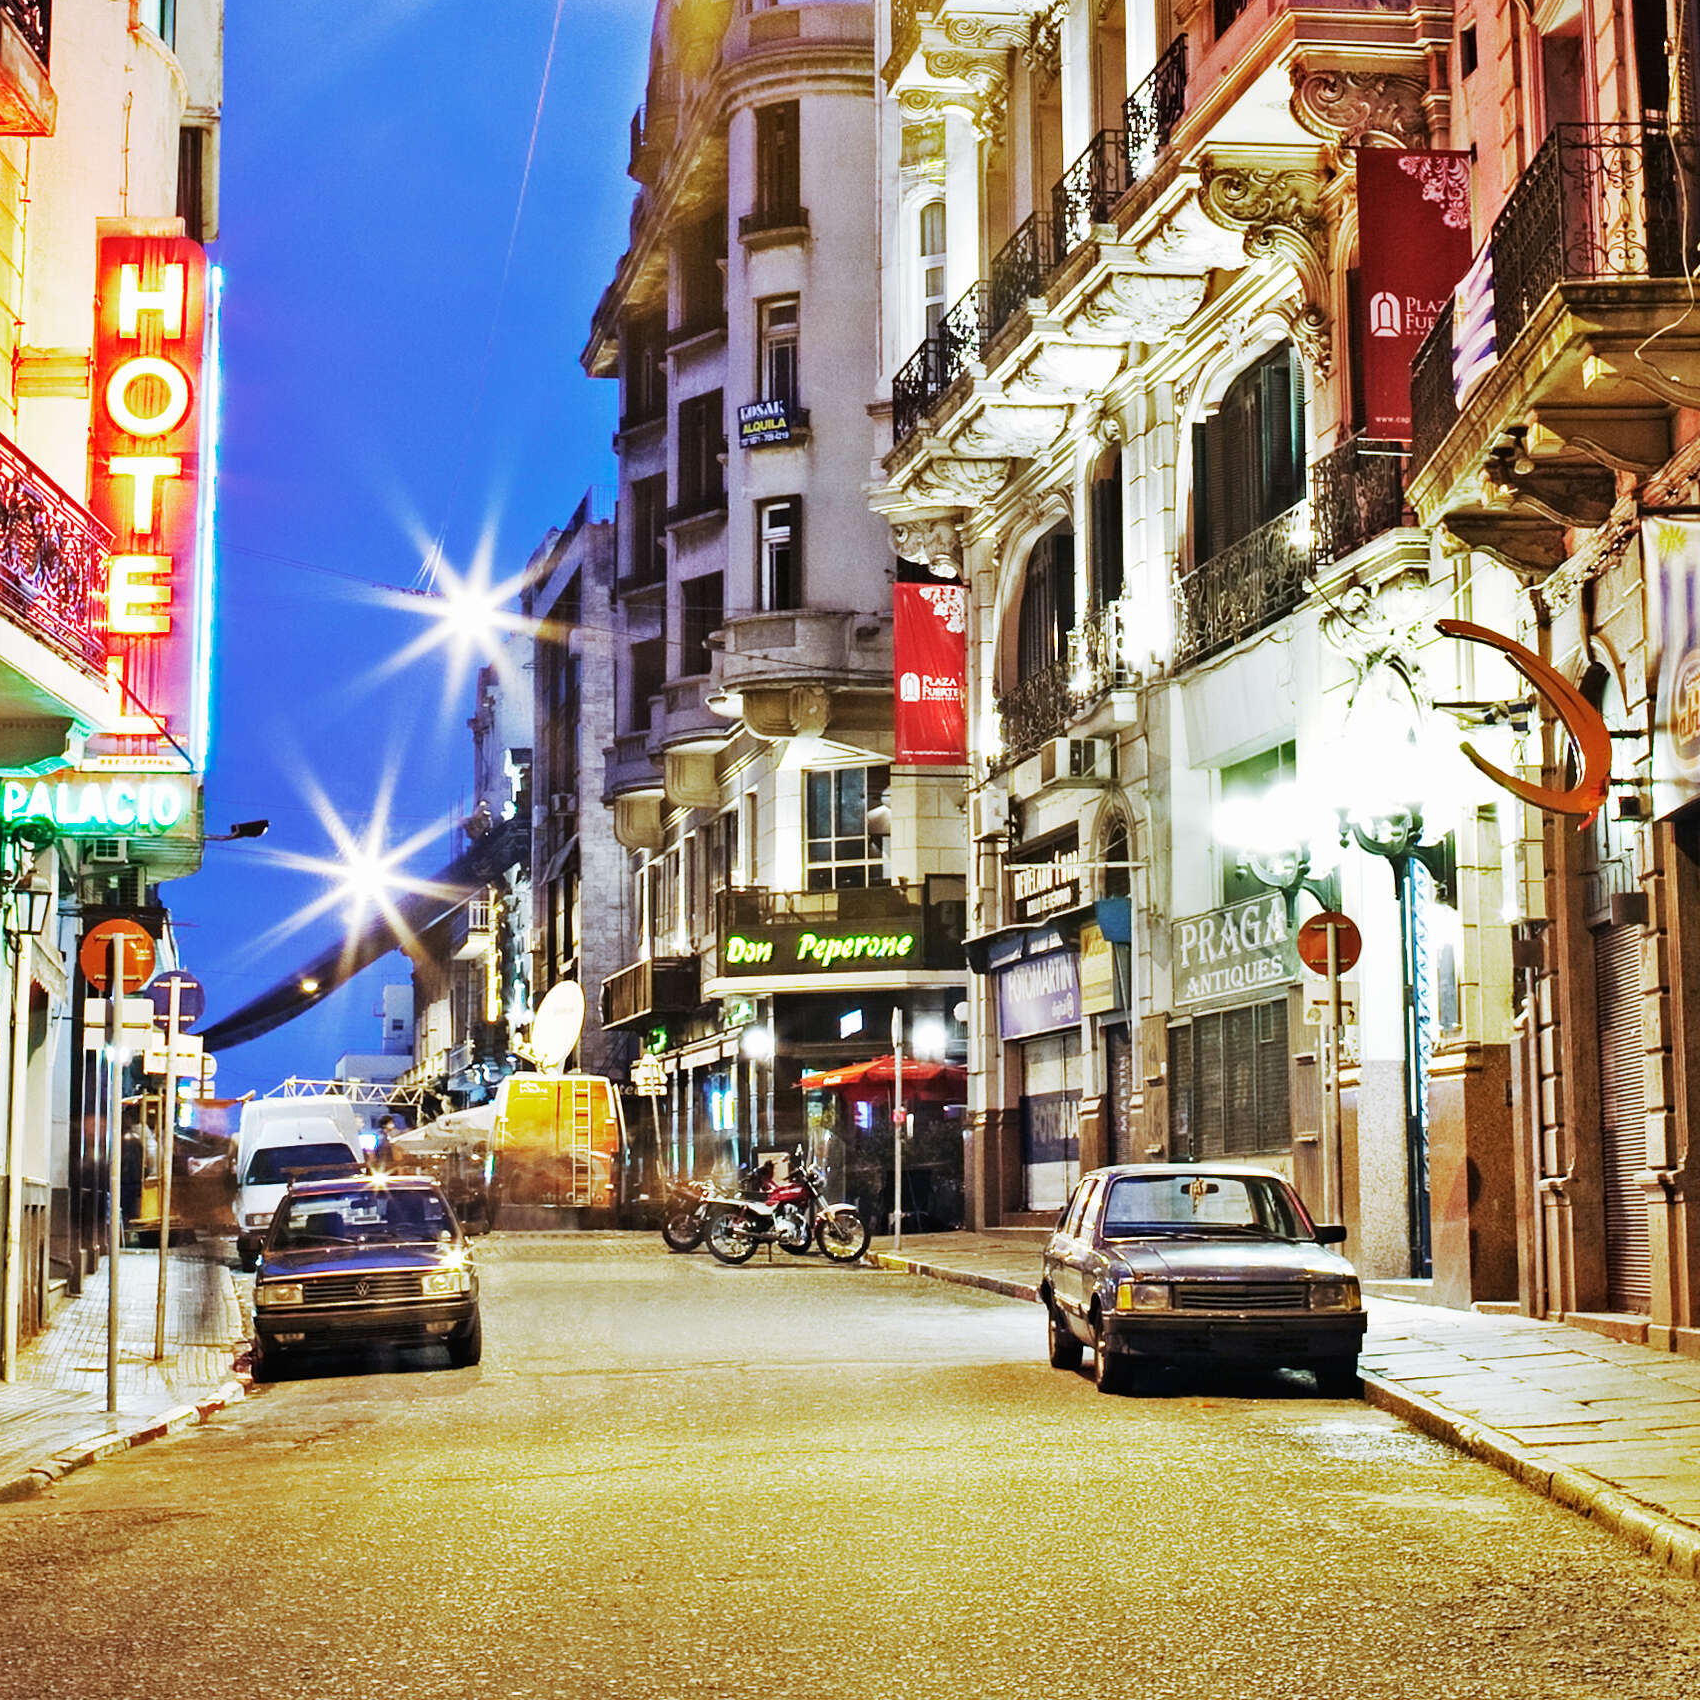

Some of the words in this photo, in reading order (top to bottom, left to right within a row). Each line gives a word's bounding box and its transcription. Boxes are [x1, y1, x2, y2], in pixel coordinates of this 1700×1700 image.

[1406, 297, 1447, 312] PLAZ
[1405, 314, 1436, 329] FUE
[743, 418, 787, 434] ALQUILA
[1375, 416, 1412, 424] www.cap
[107, 262, 191, 736] HOTEL
[922, 675, 957, 687] PLAZA
[922, 687, 959, 697] FUERTE
[3, 780, 182, 826] PALACIO
[1180, 897, 1288, 969] PRAGA
[726, 936, 773, 964] Don
[797, 933, 914, 968] Peperone
[1007, 950, 1074, 1004] FOTOMARTIN
[1184, 954, 1284, 998] ANTIQUES
